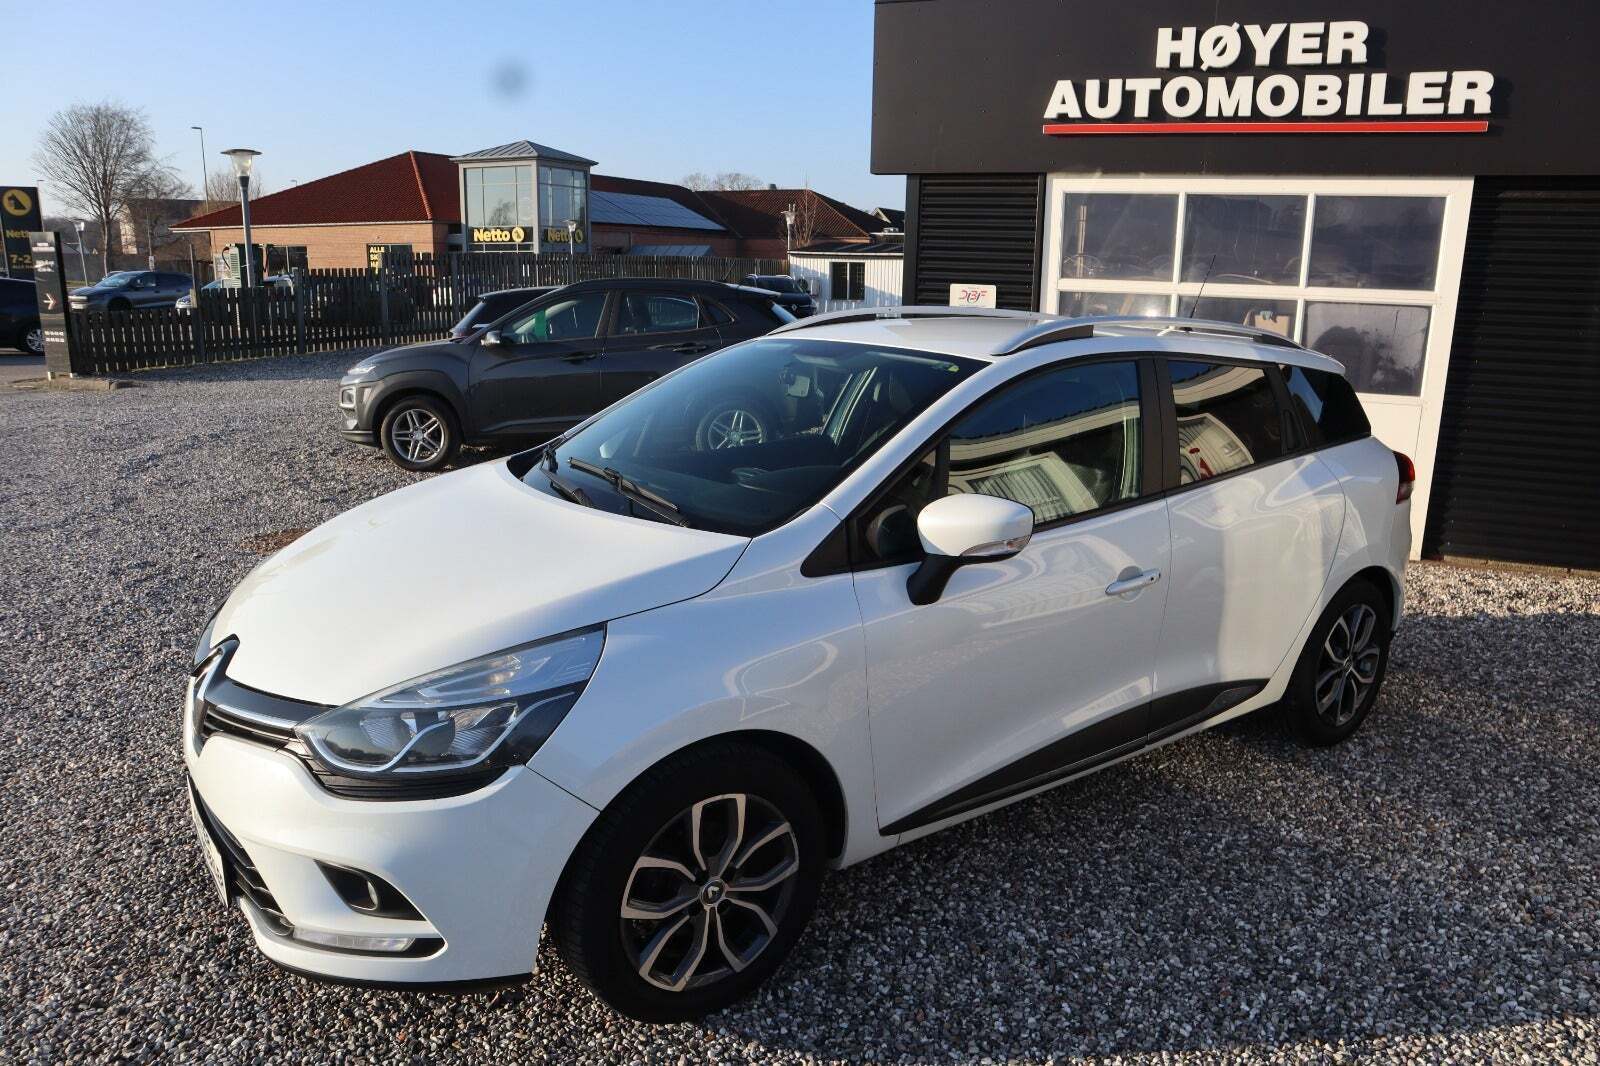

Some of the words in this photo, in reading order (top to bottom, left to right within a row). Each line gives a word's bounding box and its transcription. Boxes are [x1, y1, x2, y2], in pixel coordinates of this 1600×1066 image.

[1155, 20, 1370, 71] HØYER
[1043, 71, 1495, 119] AUTOMOBILER
[473, 228, 511, 242] Netto
